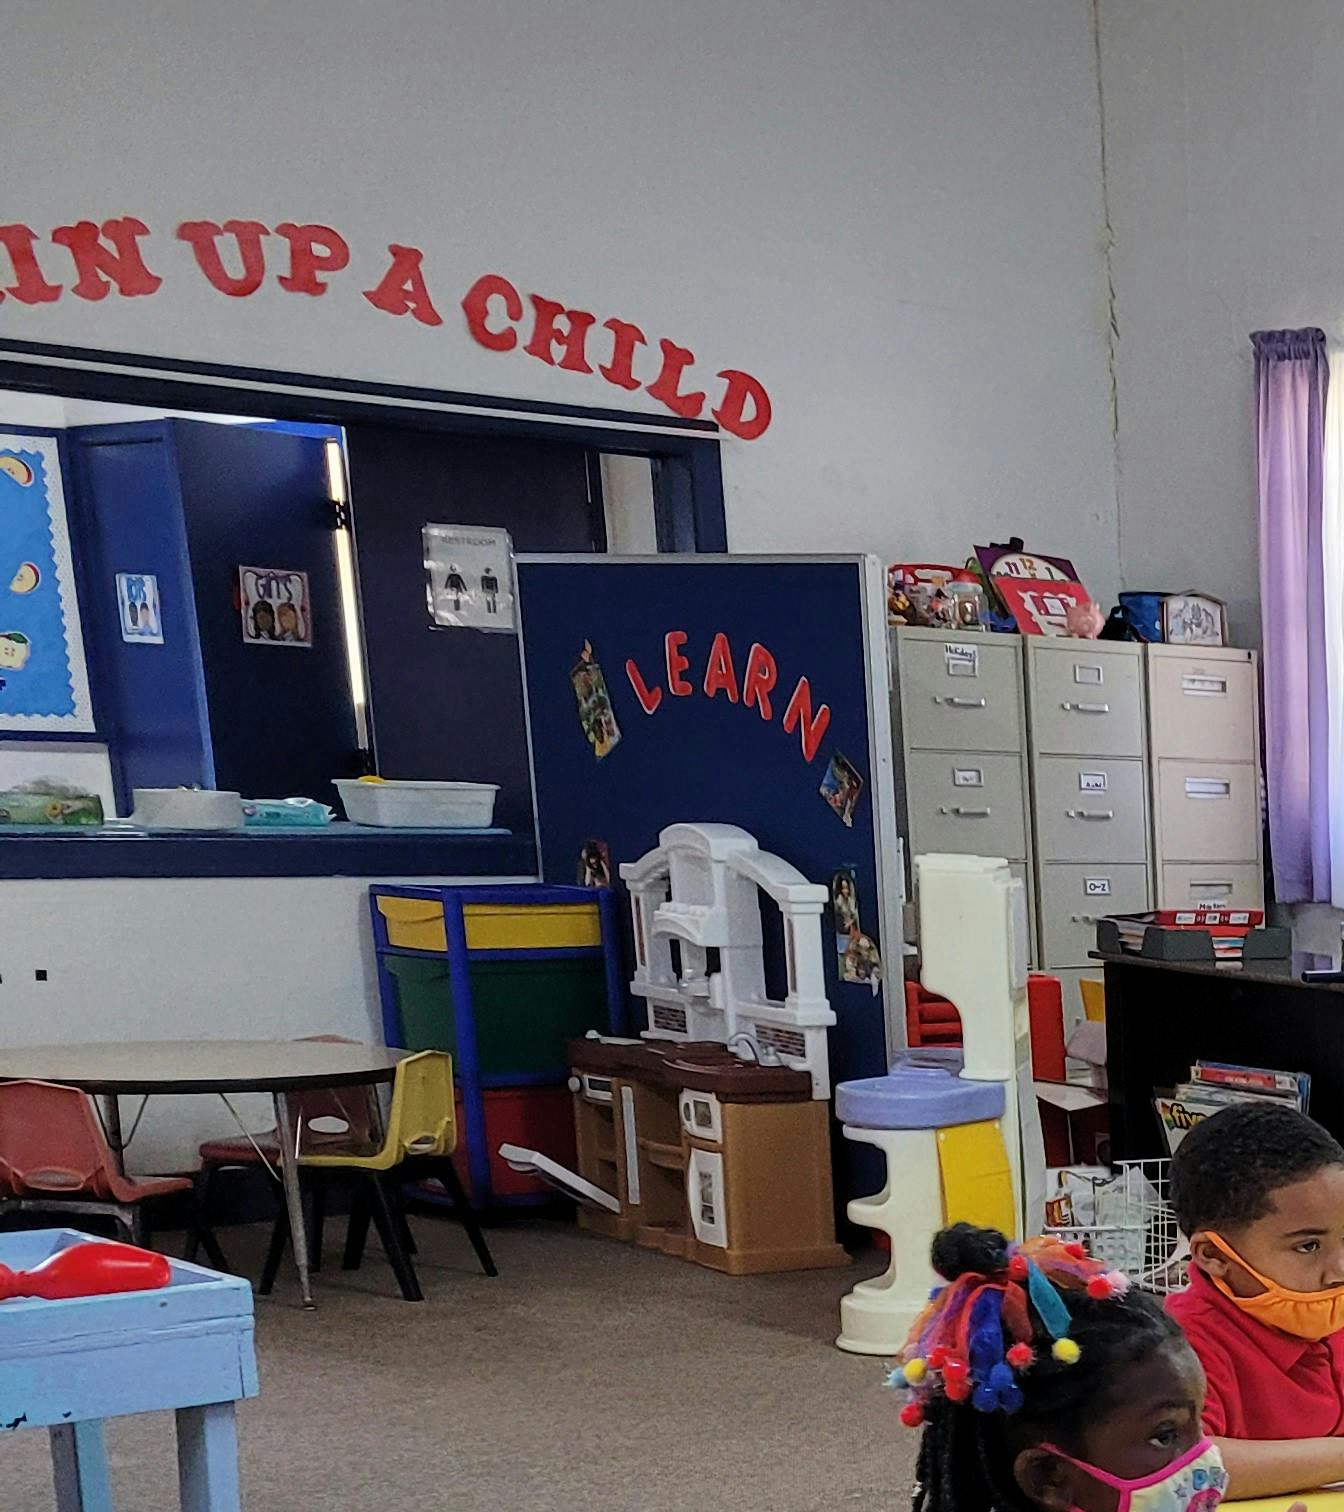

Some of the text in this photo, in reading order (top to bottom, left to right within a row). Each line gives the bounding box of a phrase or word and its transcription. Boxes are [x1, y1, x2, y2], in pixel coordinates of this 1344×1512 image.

[176, 219, 350, 298] UP
[362, 243, 443, 326] A
[461, 274, 772, 440] CHILD
[1005, 561, 1020, 575] 11
[1019, 558, 1037, 571] 12
[625, 630, 831, 763] LEARN
